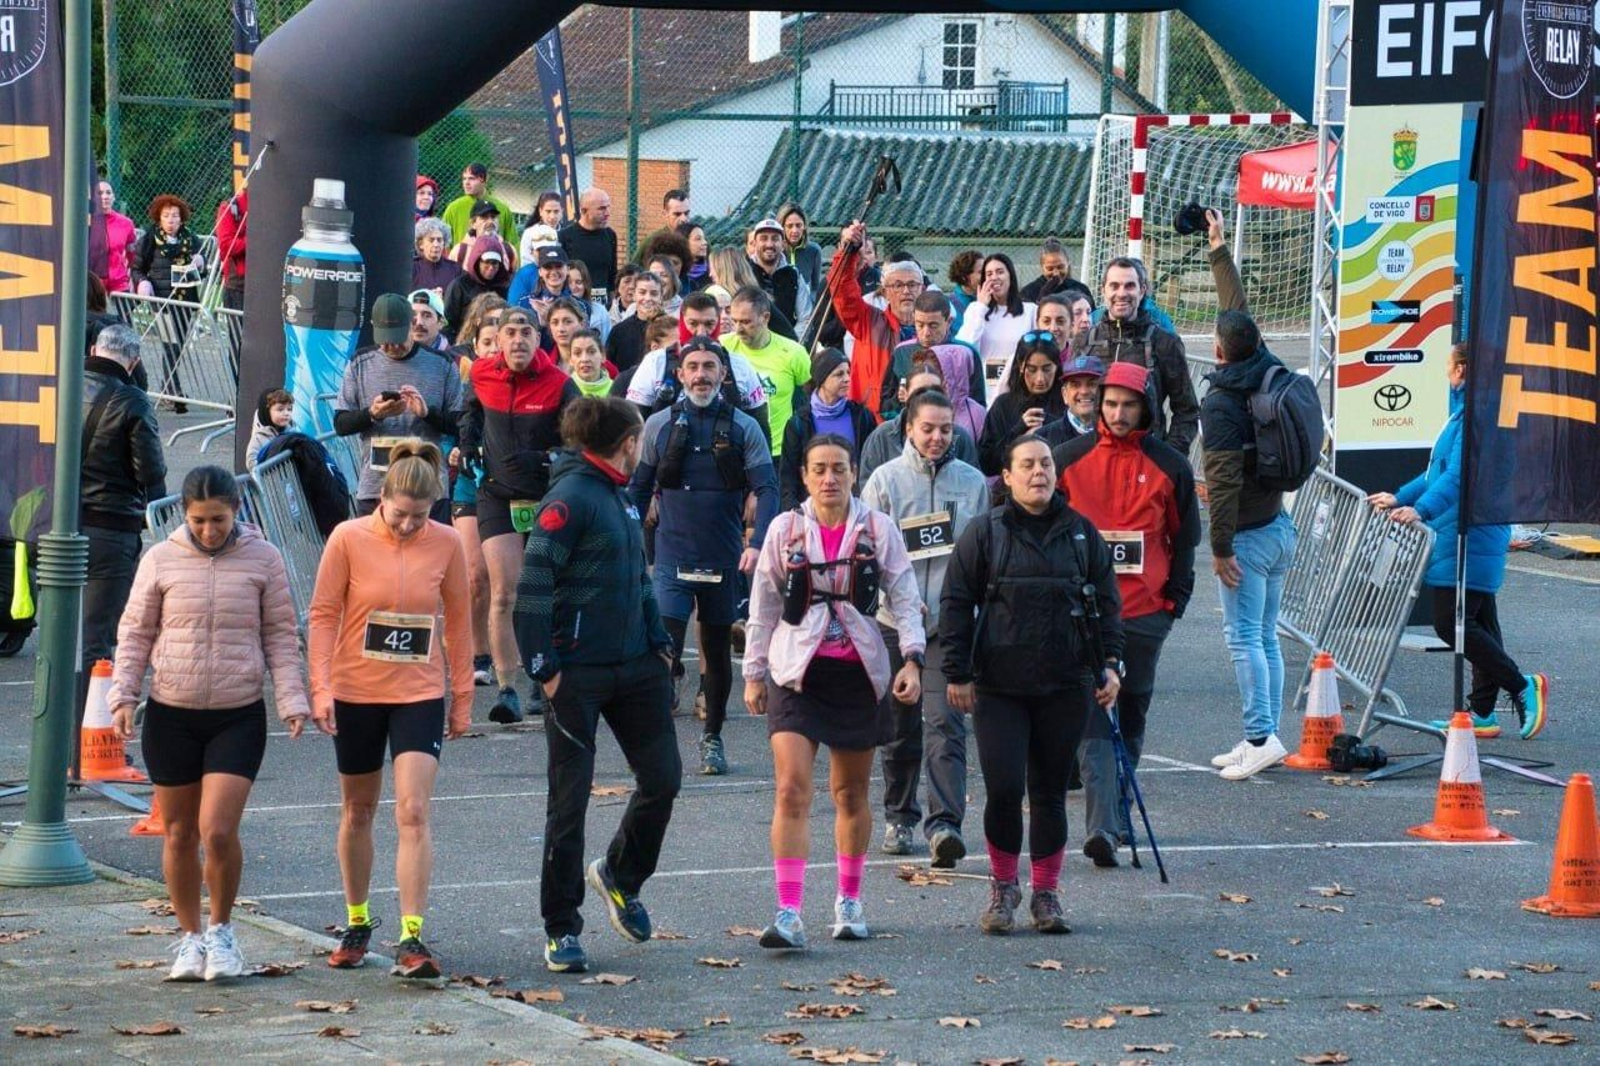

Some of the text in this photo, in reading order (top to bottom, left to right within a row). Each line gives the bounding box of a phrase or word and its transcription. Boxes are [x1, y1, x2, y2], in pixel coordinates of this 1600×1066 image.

[1546, 27, 1580, 65] RELAY
[1369, 201, 1411, 210] CONCELLO
[1374, 210, 1406, 218] DE VIGO
[1388, 248, 1405, 257] TEAM
[286, 265, 362, 282] POWERADE
[1386, 264, 1405, 273] RELAY
[1498, 129, 1597, 428] TEAM
[1373, 353, 1420, 362] xtrembike
[1372, 417, 1414, 427] NIPOCAR
[919, 526, 945, 546] 52
[384, 630, 412, 650] 42
